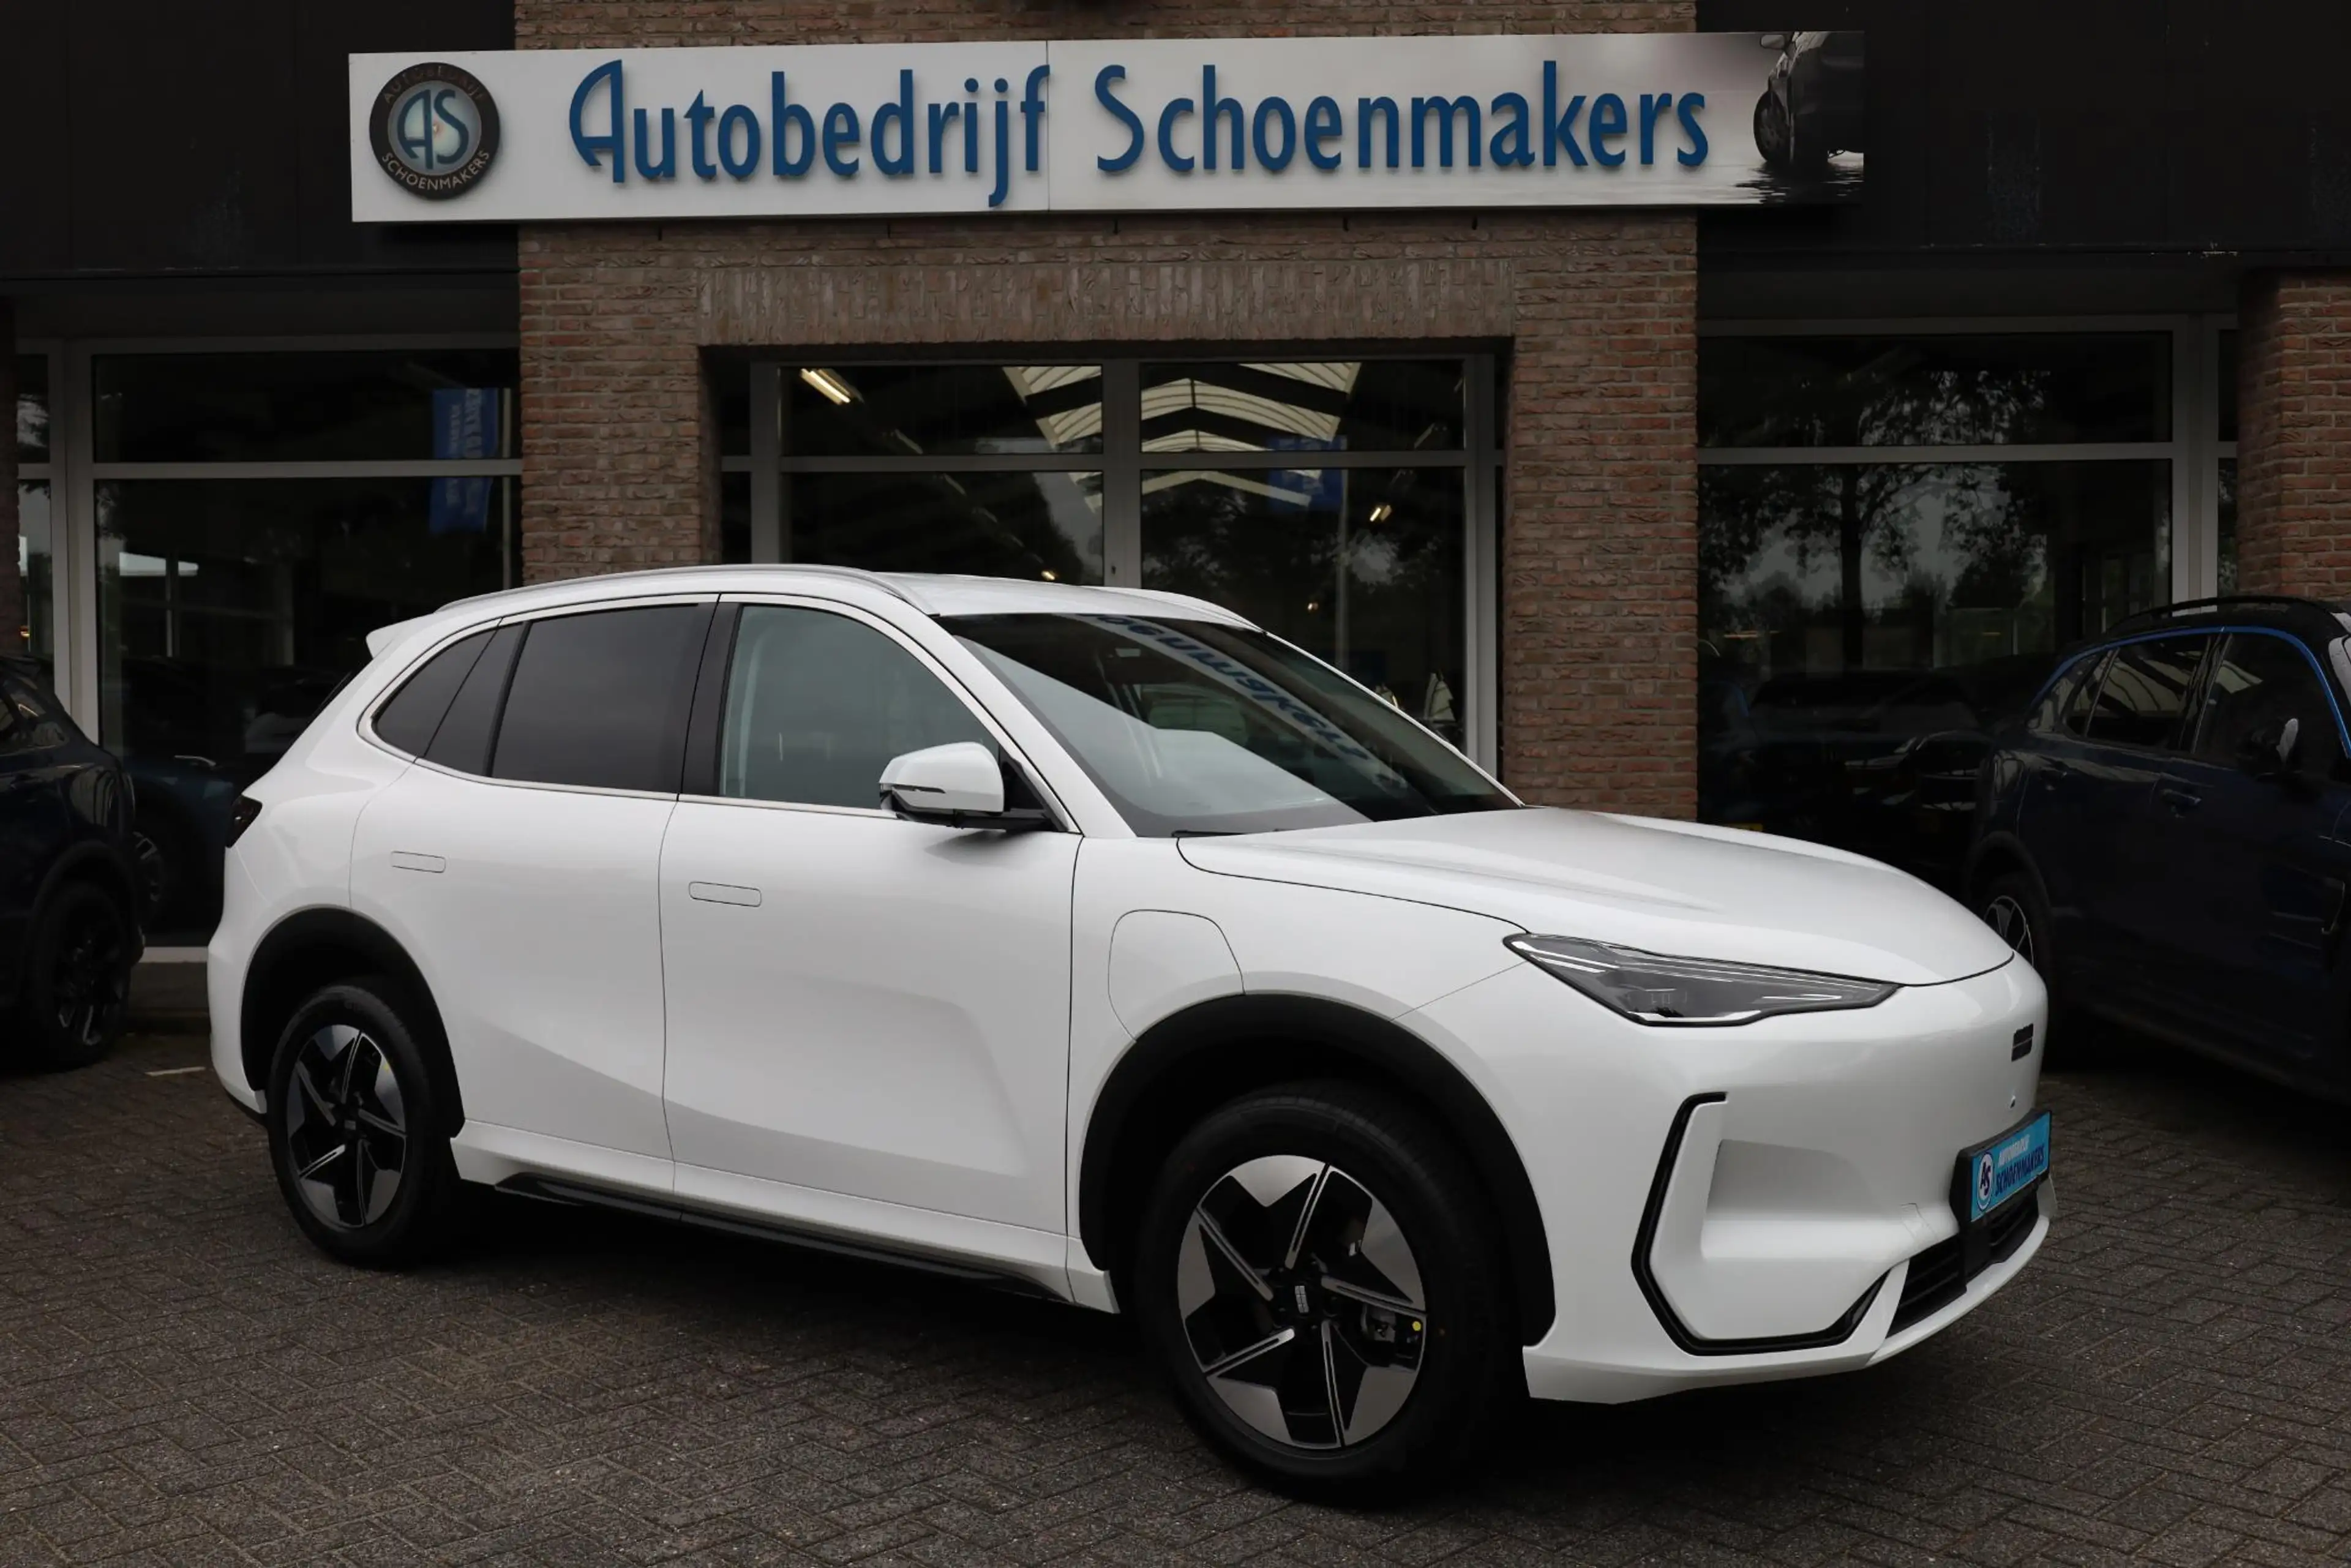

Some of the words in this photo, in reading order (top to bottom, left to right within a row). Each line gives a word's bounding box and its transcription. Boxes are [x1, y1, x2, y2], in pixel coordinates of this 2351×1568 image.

[397, 89, 469, 170] AS
[569, 59, 1050, 207] Autobedrijf
[1095, 61, 1709, 173] Schoenmakers
[382, 151, 489, 190] SCHOENMAKERS
[1980, 1161, 1992, 1196] AS
